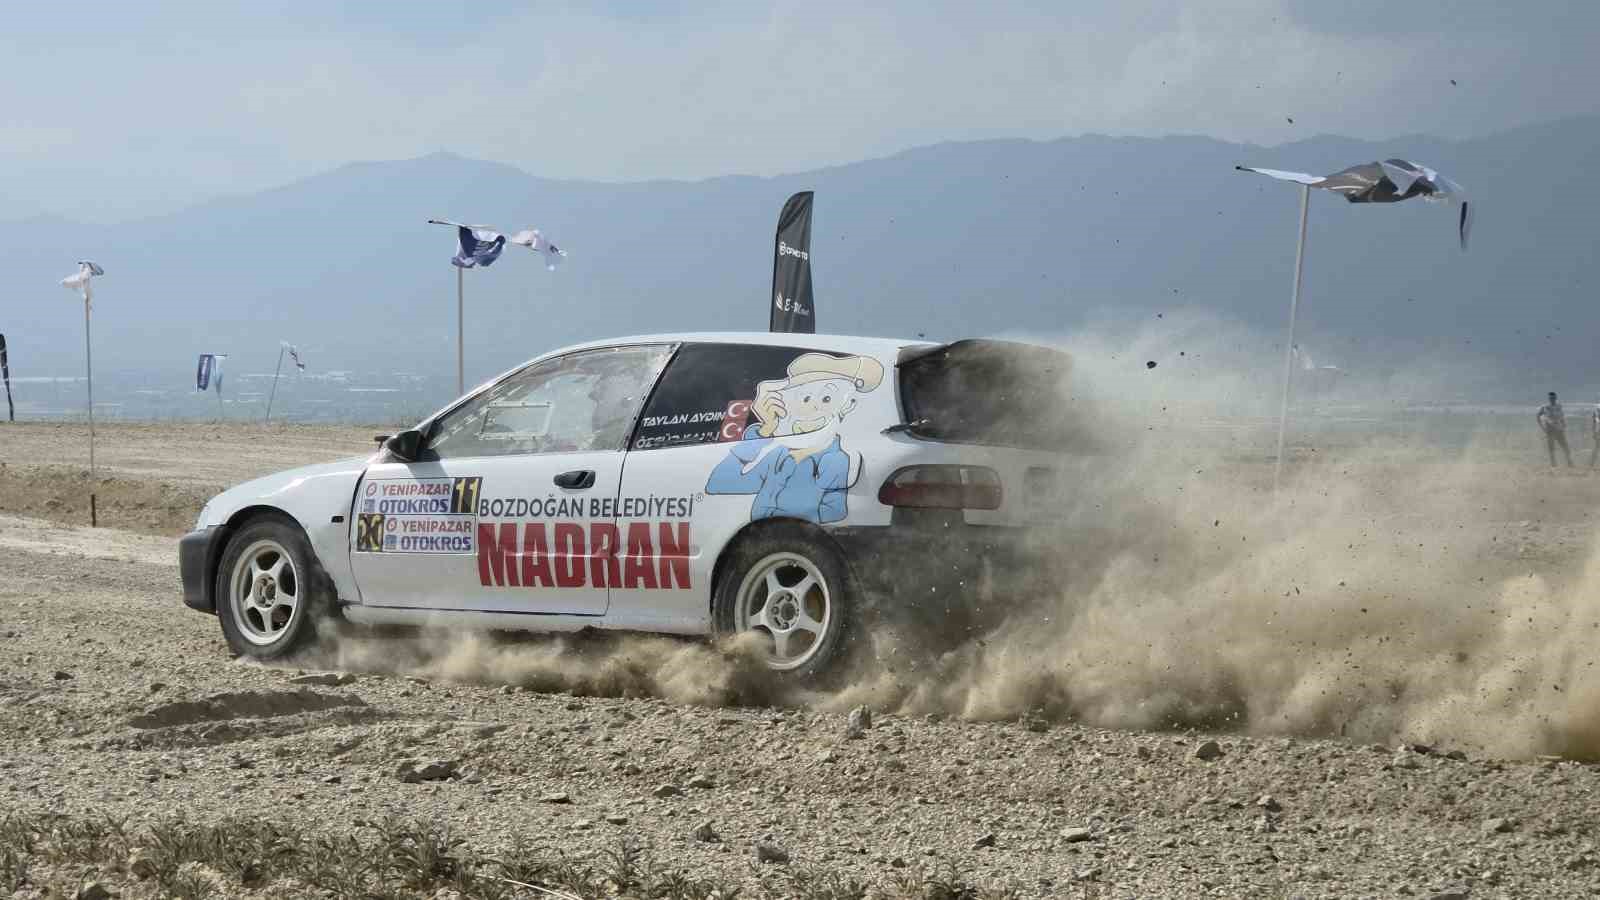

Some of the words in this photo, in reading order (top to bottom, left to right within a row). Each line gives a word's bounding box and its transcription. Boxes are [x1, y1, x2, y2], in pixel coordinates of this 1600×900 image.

[643, 413, 689, 427] TAYLAN
[689, 411, 727, 423] AYDIN
[456, 478, 480, 513] 11
[379, 499, 449, 514] OTOKROS
[479, 494, 584, 517] BOZDOĞAN
[589, 494, 694, 518] BELEDİYESİ
[400, 535, 472, 551] OTOKROS
[477, 522, 692, 589] MADRAN
